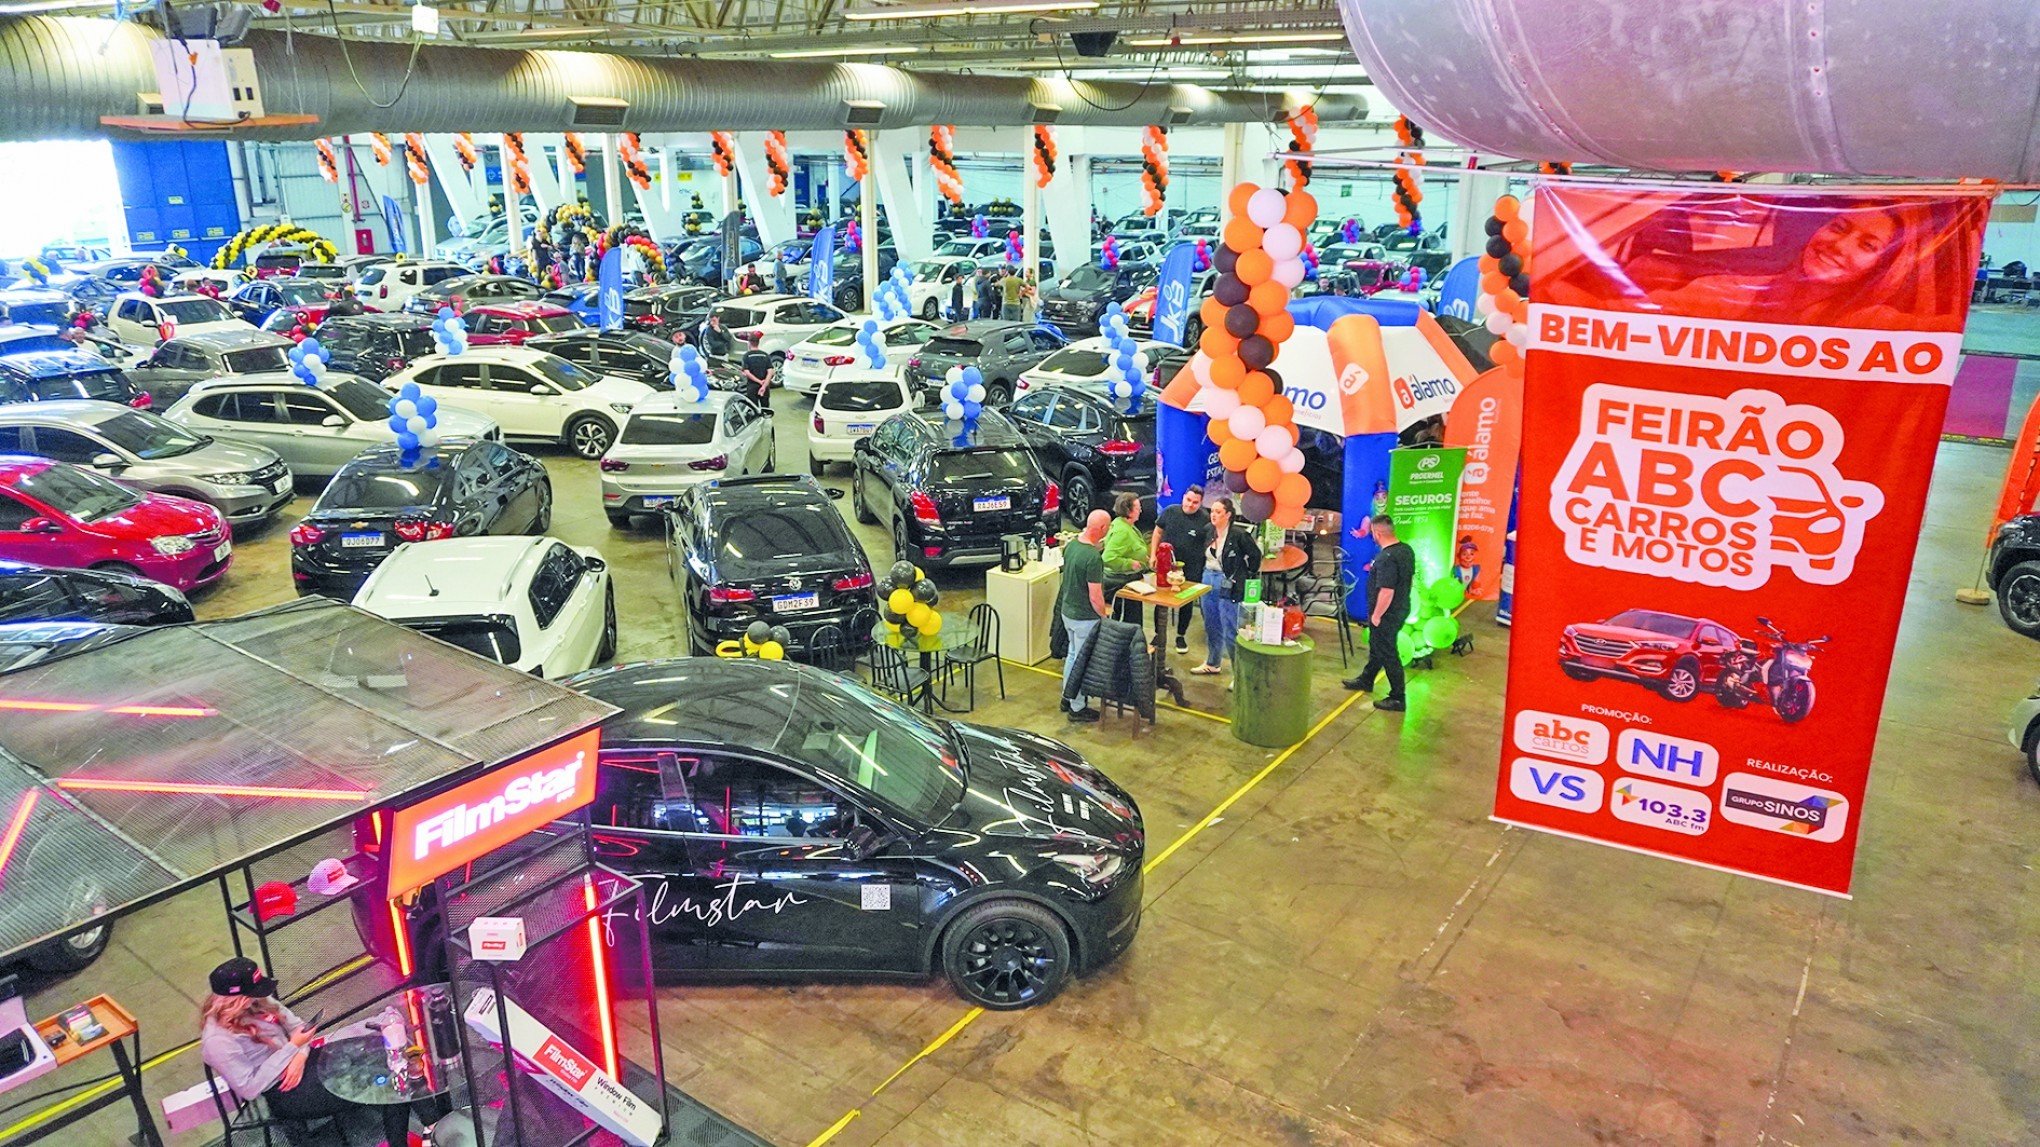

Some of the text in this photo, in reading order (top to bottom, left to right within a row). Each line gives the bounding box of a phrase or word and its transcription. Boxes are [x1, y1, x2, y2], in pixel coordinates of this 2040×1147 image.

[1540, 313, 1943, 374] BEM-VINDOS AO
[1596, 398, 1824, 459] FEIRÃO
[1567, 441, 1766, 517] ABC
[1394, 492, 1453, 506] SEGUROS
[1564, 497, 1758, 550] CARROS
[1579, 528, 1754, 576] E MOTOS
[1581, 704, 1652, 725] PROMOÇÃO:
[1532, 737, 1589, 754] carros
[1533, 720, 1590, 745] abc
[1631, 738, 1703, 777] NH
[1746, 758, 1833, 783] REALIZAÇÃO:
[1529, 767, 1586, 801] VS
[414, 754, 583, 861] FilmStar
[1638, 798, 1706, 823] 103.3
[1731, 795, 1820, 821] GRUPO SINOS
[1665, 817, 1705, 832] ABC fm
